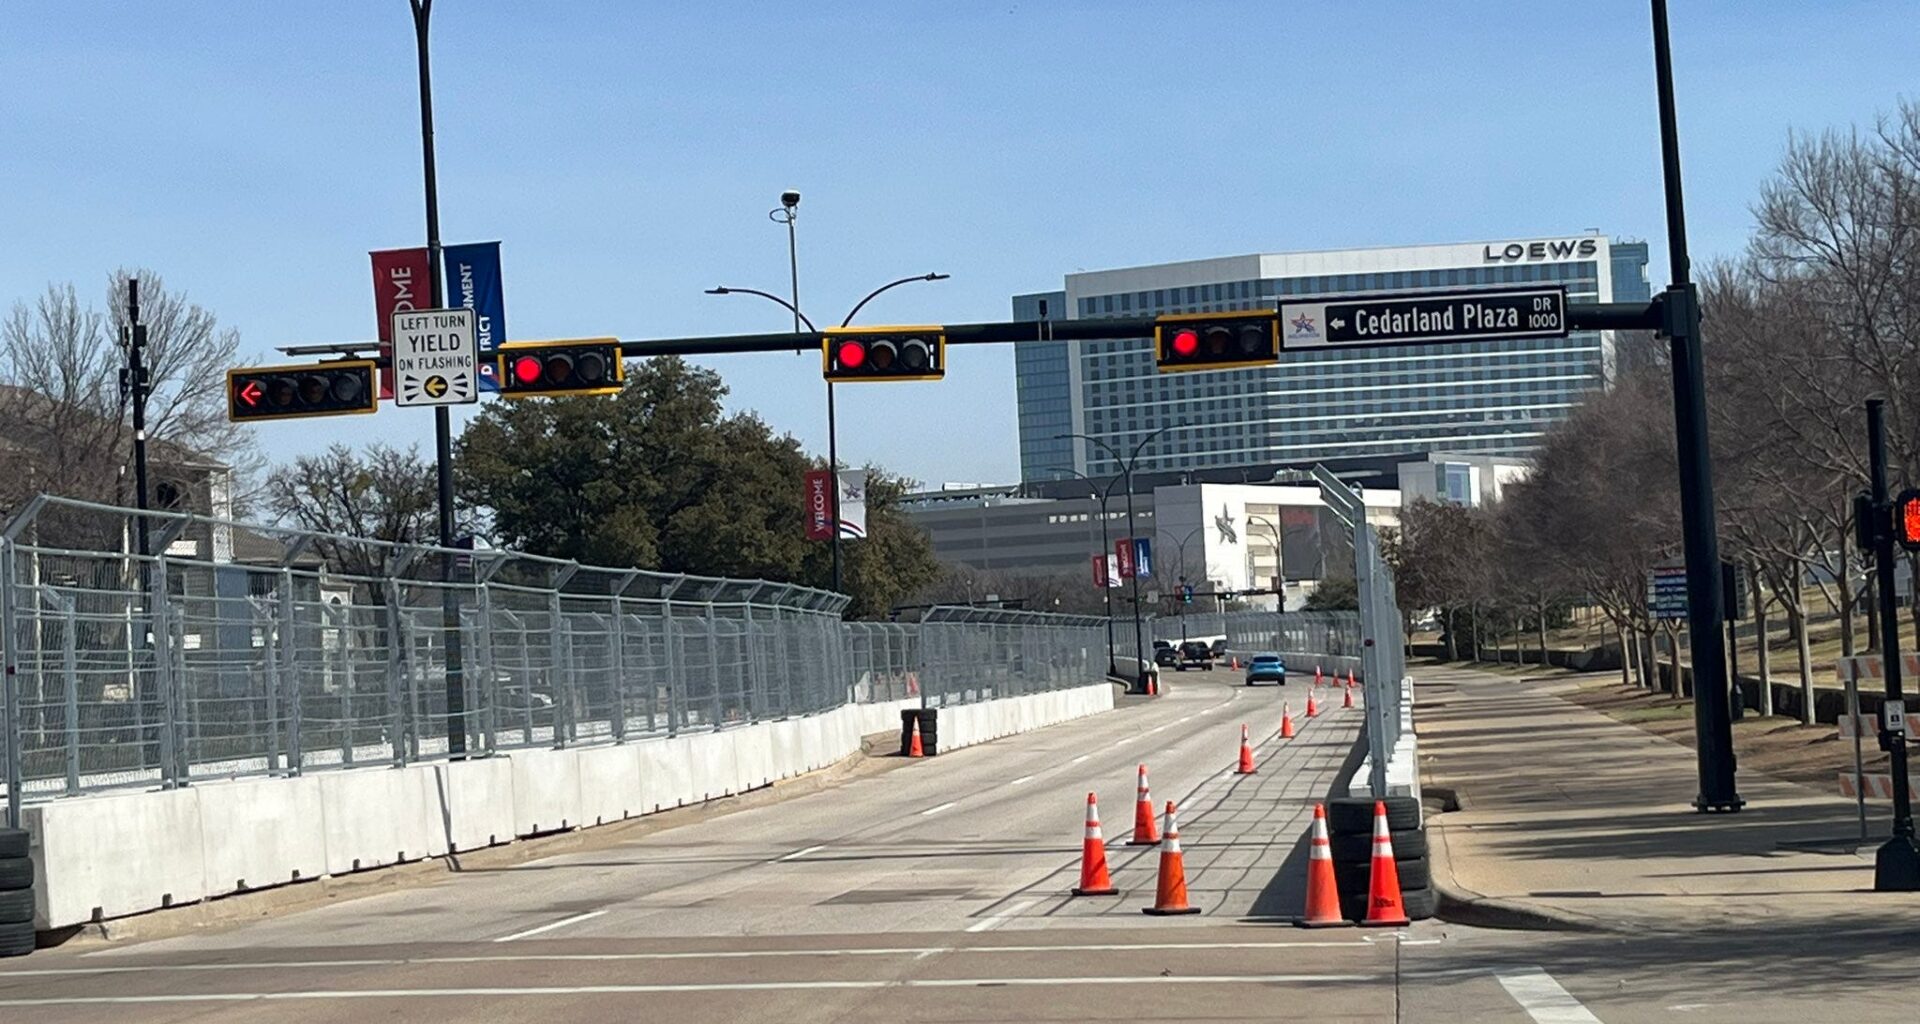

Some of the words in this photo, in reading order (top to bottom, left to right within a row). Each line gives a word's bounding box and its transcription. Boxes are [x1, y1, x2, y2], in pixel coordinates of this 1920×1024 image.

[1483, 239, 1597, 263] LOEWS
[1533, 297, 1552, 311] DR
[401, 317, 429, 330] LEFT
[433, 315, 465, 328] TURN
[1355, 304, 1454, 335] Cedarland
[1463, 303, 1518, 329] Plaza
[1528, 313, 1558, 328] 1000
[408, 333, 461, 353] YIELD
[399, 358, 414, 371] ON
[418, 355, 471, 370] FLASHING
[812, 479, 825, 532] WELCOME
